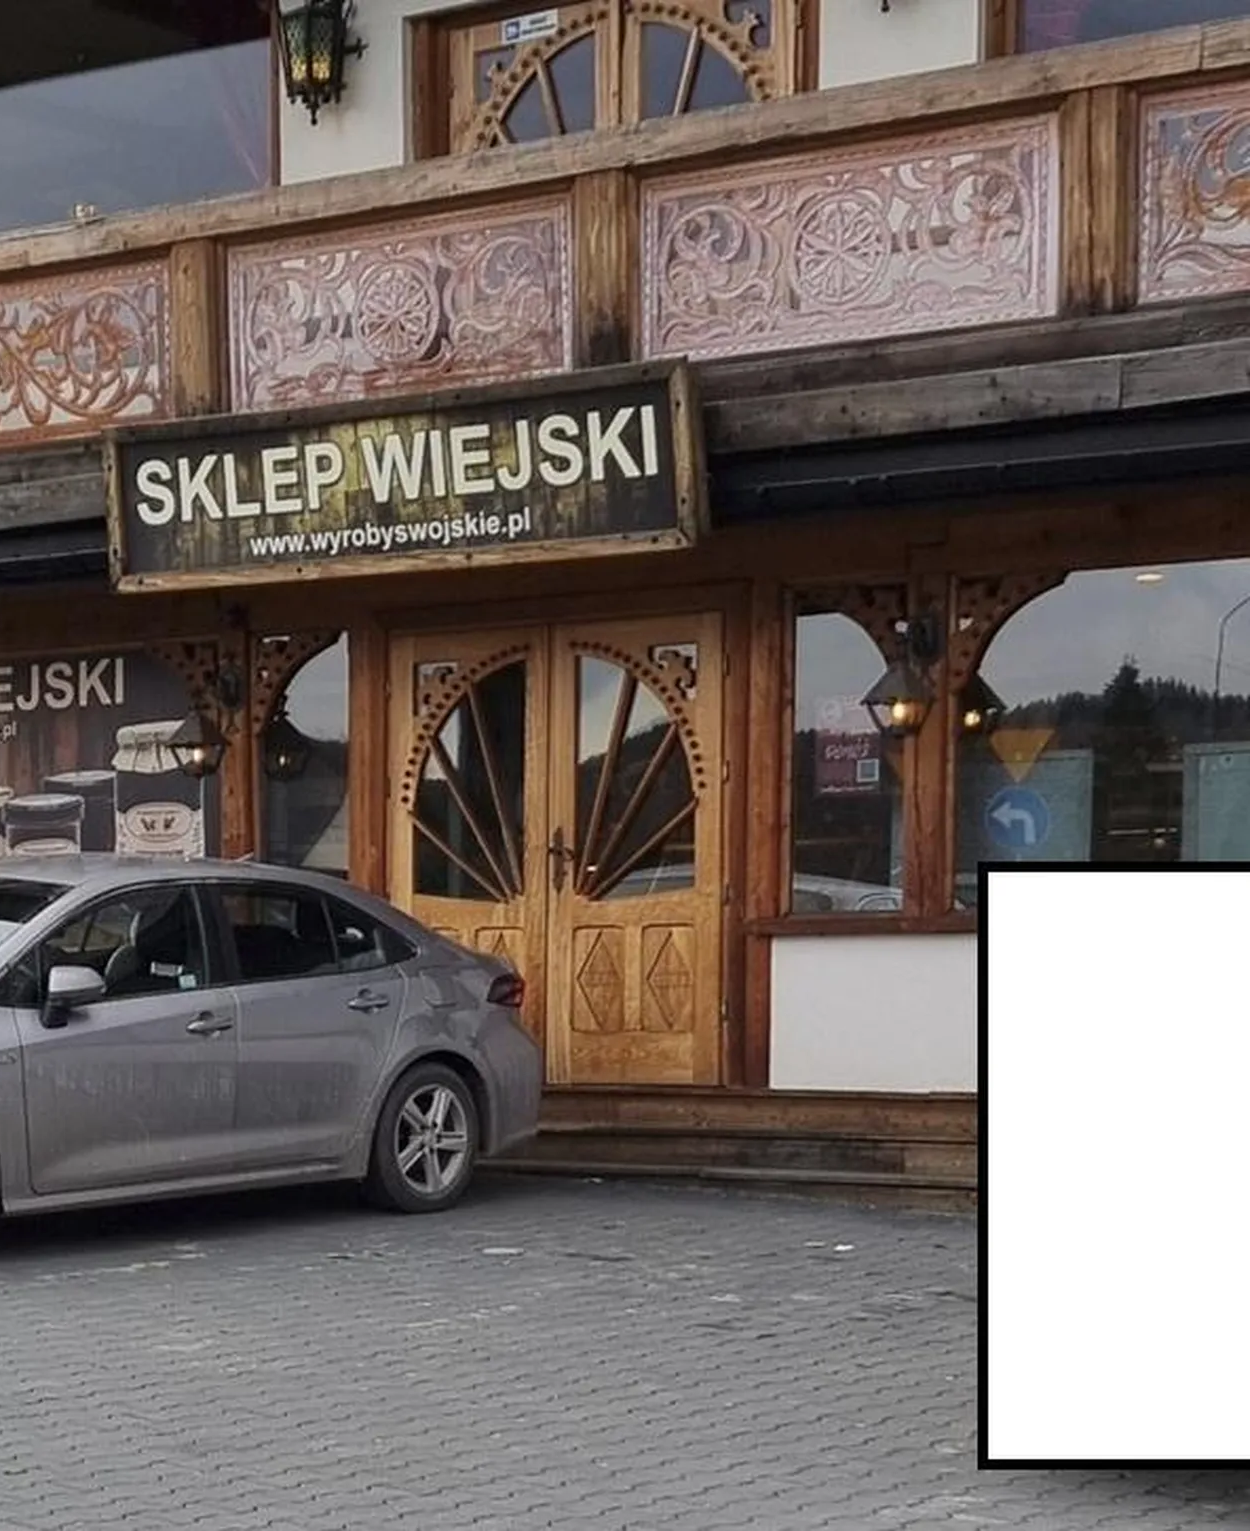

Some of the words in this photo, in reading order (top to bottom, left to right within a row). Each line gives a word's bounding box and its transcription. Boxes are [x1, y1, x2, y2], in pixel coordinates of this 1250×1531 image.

[136, 440, 344, 526] SKLEP
[361, 404, 659, 503] WIEJSKI
[249, 506, 532, 557] www.wyrobyswojskie.pl
